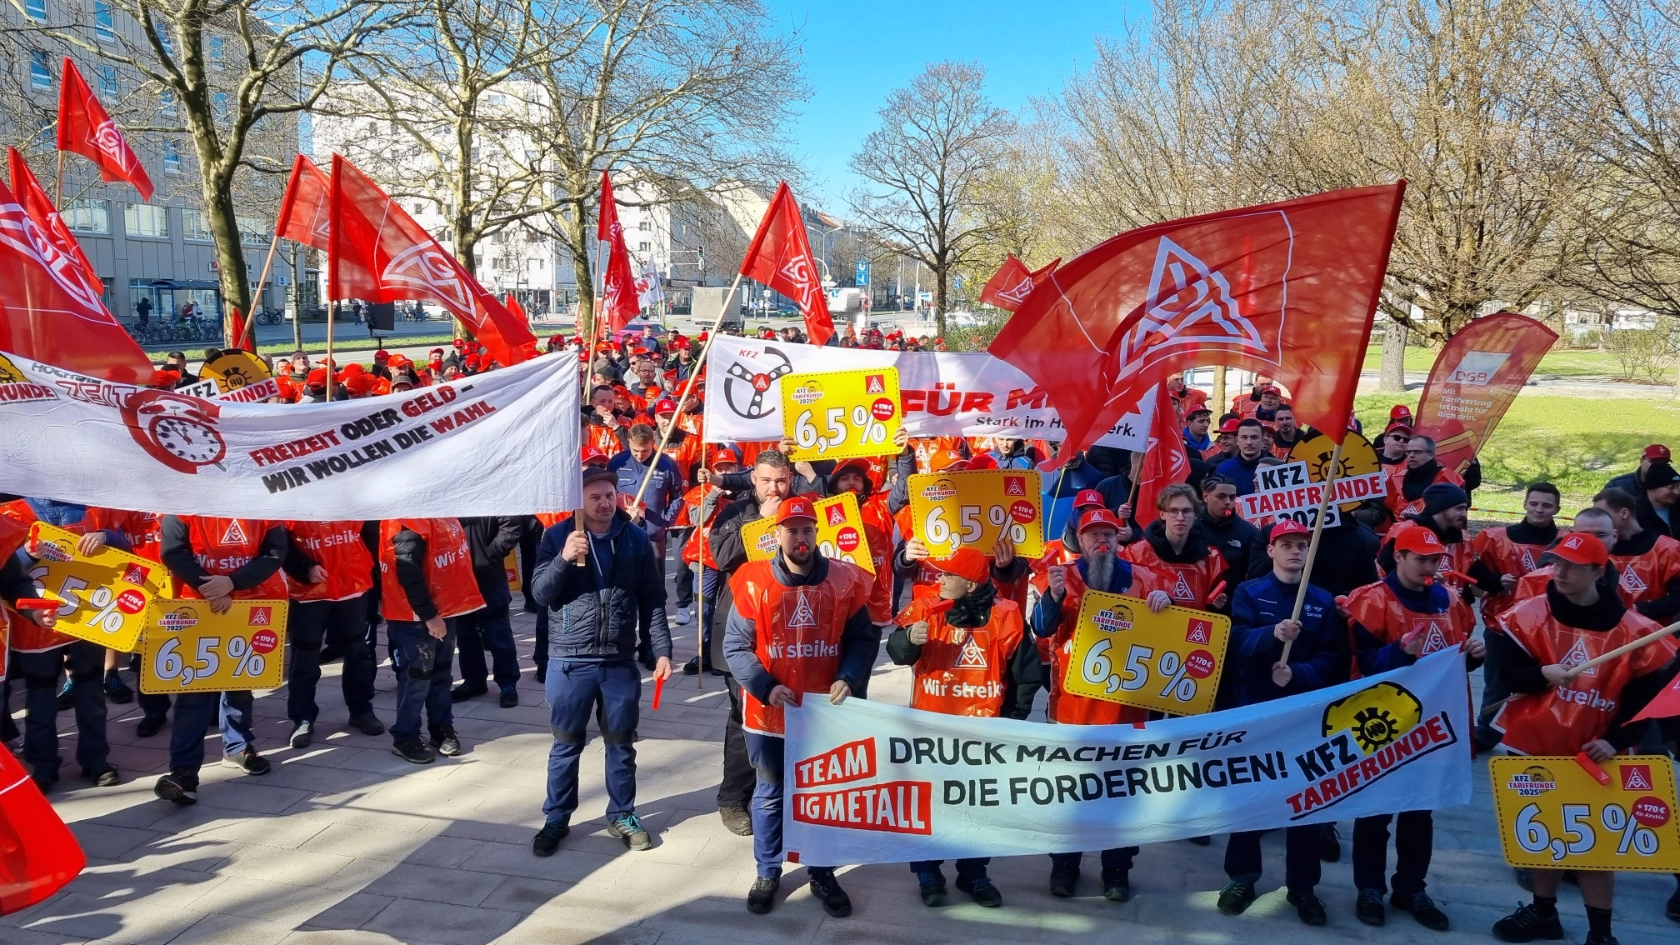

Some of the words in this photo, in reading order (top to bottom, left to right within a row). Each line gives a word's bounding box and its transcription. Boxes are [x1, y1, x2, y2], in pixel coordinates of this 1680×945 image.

[738, 348, 759, 359] KFZ
[229, 377, 242, 387] HU
[1454, 370, 1488, 383] DGB
[56, 380, 138, 408] ZEIT
[900, 382, 994, 418] FÜR
[1441, 395, 1493, 408] Tarifvertrag
[1451, 404, 1473, 414] mehr
[1457, 413, 1477, 422] drin.
[249, 429, 342, 467] FREIZEIT
[340, 408, 404, 441] ODER
[401, 385, 457, 418] GELD
[976, 415, 1018, 428] Stark
[1025, 416, 1044, 429] im
[261, 467, 311, 494] WIR
[307, 439, 397, 480] WOLLEN
[392, 425, 434, 450] DIE
[429, 399, 497, 435] WAHL
[1261, 465, 1304, 490] KFZ
[44, 541, 56, 550] KFZ
[760, 534, 770, 542] KFZ
[1100, 610, 1113, 618] KFZ
[1100, 624, 1117, 632] 2025
[923, 678, 947, 697] Wir
[1366, 718, 1387, 737] HU
[889, 736, 1007, 766] DRUCK
[1016, 743, 1170, 763] MACHEN
[1178, 730, 1247, 755] FÜR
[799, 744, 868, 784] TEAM
[1286, 716, 1449, 814] TARIFRUNDE
[1295, 735, 1358, 783] KFZ
[943, 778, 1000, 806] DIE
[1009, 750, 1289, 806] FORDERUNGEN!
